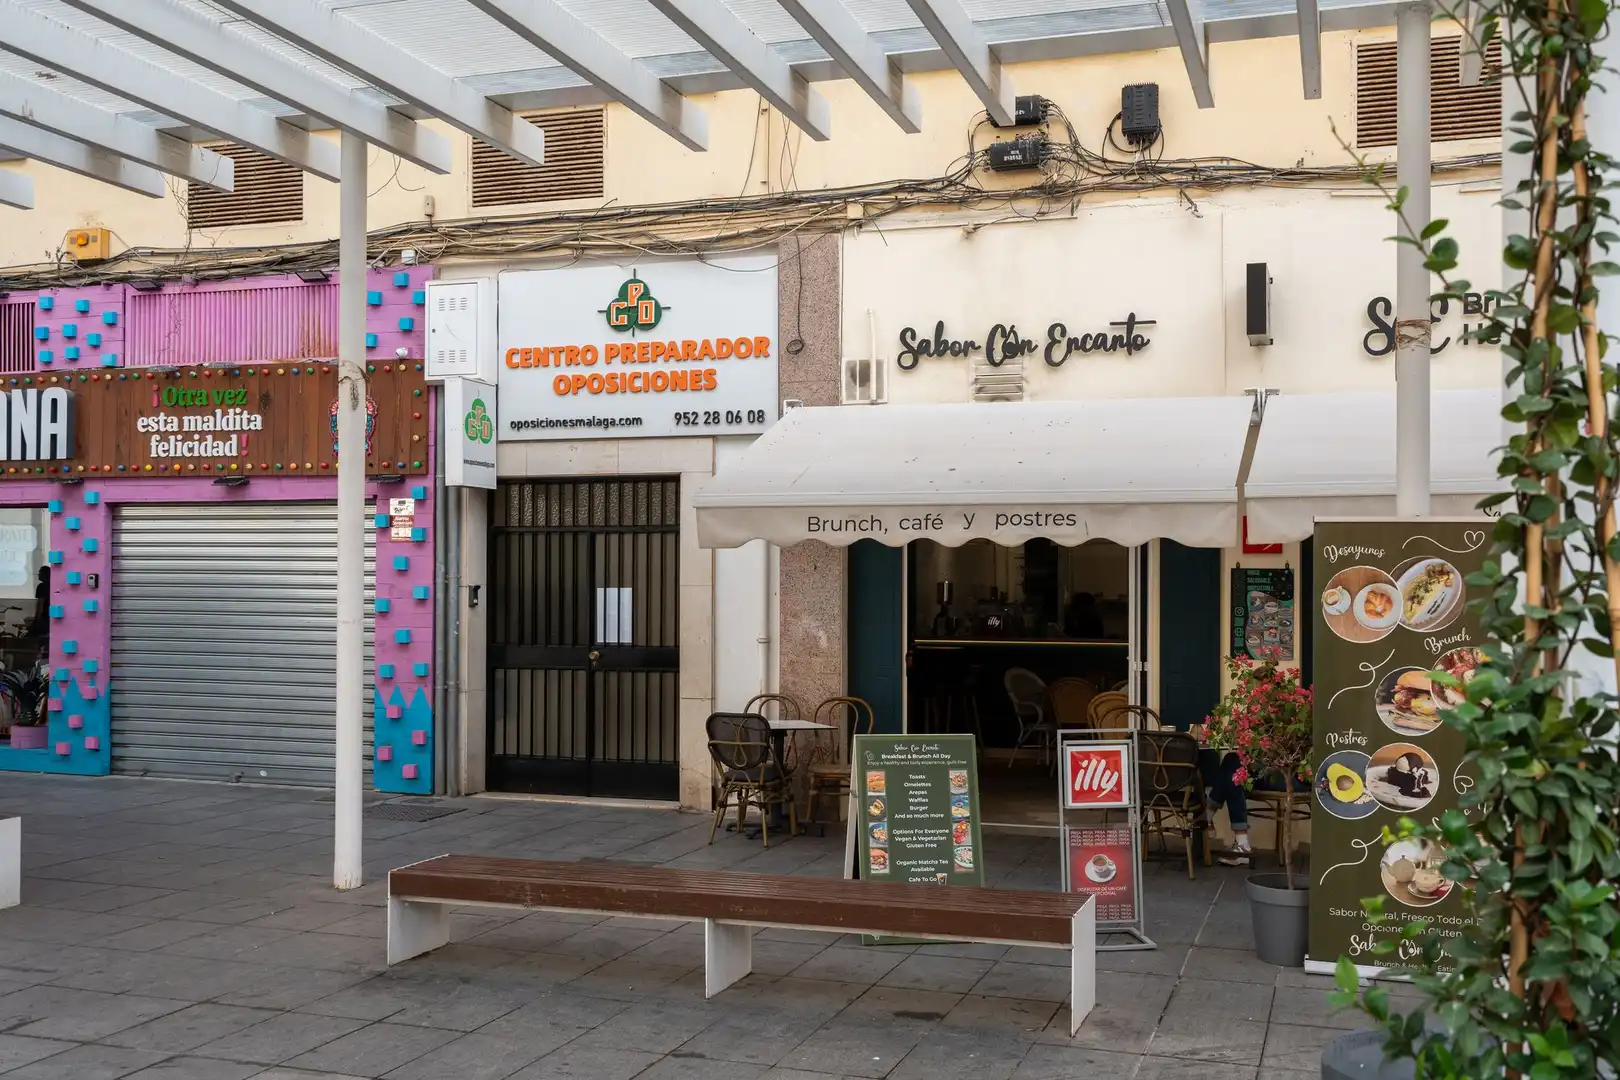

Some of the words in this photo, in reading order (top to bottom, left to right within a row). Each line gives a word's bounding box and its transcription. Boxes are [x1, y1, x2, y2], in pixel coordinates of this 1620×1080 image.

[506, 344, 598, 368] CENTRO
[604, 336, 771, 365] PREPARADOR
[897, 321, 982, 370] Sabor
[1044, 312, 1157, 367] Encanto
[553, 368, 718, 396] OPOSICIONES
[213, 387, 248, 406] vez
[0, 387, 68, 460] NA
[137, 411, 180, 433] esta
[182, 408, 263, 431] maldita
[510, 414, 643, 432] oposicionesmalaga.com
[674, 411, 699, 426] 952
[703, 411, 720, 425] 28
[725, 410, 743, 425] 06
[748, 409, 766, 424] 08
[807, 515, 889, 534] Brunch,
[899, 514, 944, 531] café
[962, 512, 976, 530] y
[995, 511, 1077, 530] postres
[1323, 544, 1385, 563] Desayunos
[988, 616, 1001, 627] illy
[1423, 627, 1471, 655] Brunch
[1325, 728, 1368, 748] Postres
[1074, 758, 1119, 798] illy
[1329, 907, 1357, 917] Sabor
[1360, 909, 1399, 921] Nral,
[1401, 912, 1435, 923] Fresco
[1436, 915, 1462, 925] Todo
[1362, 923, 1405, 934] Opcione
